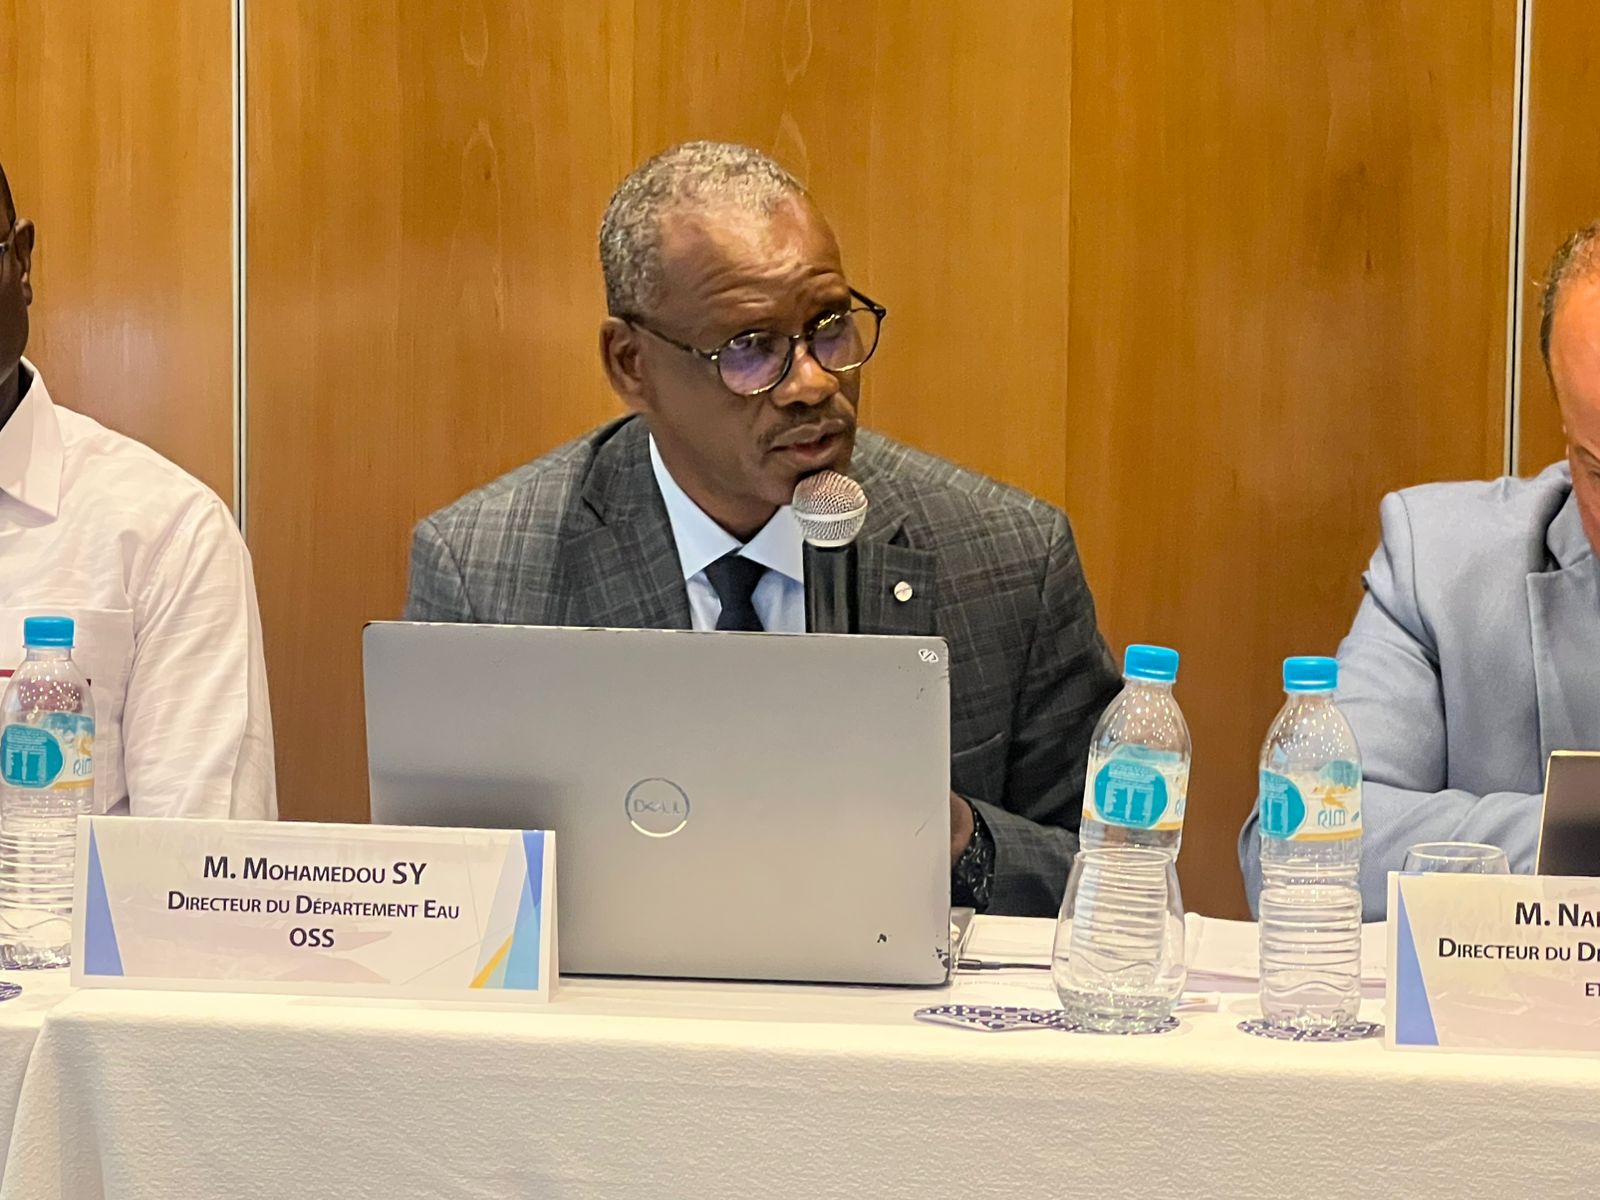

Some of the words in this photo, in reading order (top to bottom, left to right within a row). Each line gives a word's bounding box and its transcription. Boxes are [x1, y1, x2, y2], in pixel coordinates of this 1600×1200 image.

[633, 798, 681, 815] DELL
[203, 855, 236, 879] M.
[243, 857, 386, 884] MOHAMEDOU
[392, 862, 427, 885] SY
[167, 890, 262, 913] DIRECTEUR
[266, 899, 290, 914] DU
[295, 894, 419, 918] DÉPARTEMENT
[423, 899, 459, 919] EAU
[1515, 902, 1551, 926] M.
[289, 927, 335, 948] OSS
[1438, 937, 1540, 960] DIRECTEUR
[1545, 946, 1571, 961] DU
